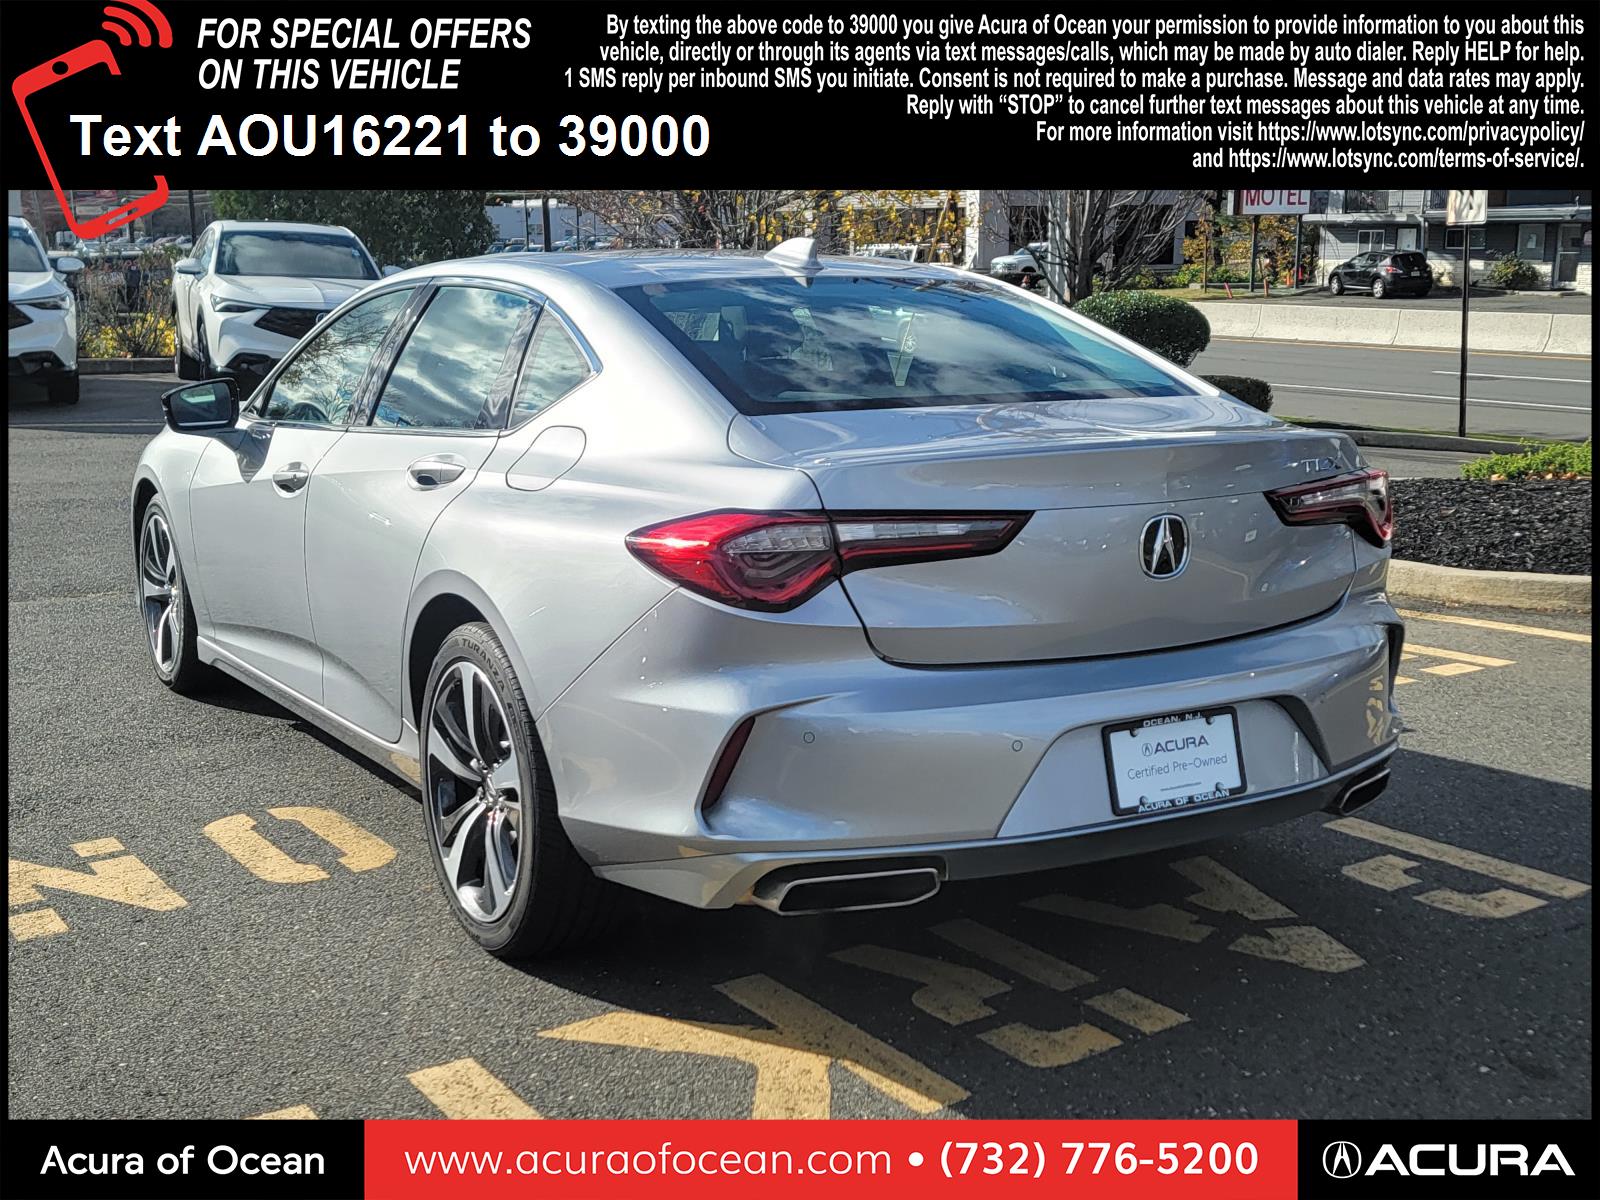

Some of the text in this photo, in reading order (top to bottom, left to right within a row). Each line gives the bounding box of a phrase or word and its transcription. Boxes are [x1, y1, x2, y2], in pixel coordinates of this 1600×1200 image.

[1245, 190, 1307, 206] MOTEL
[461, 638, 505, 692] TURANZA
[1154, 735, 1209, 754] ACURA
[1127, 754, 1228, 780] Certified Pre-Owned
[1138, 789, 1230, 813] ACURA OF OCEAN
